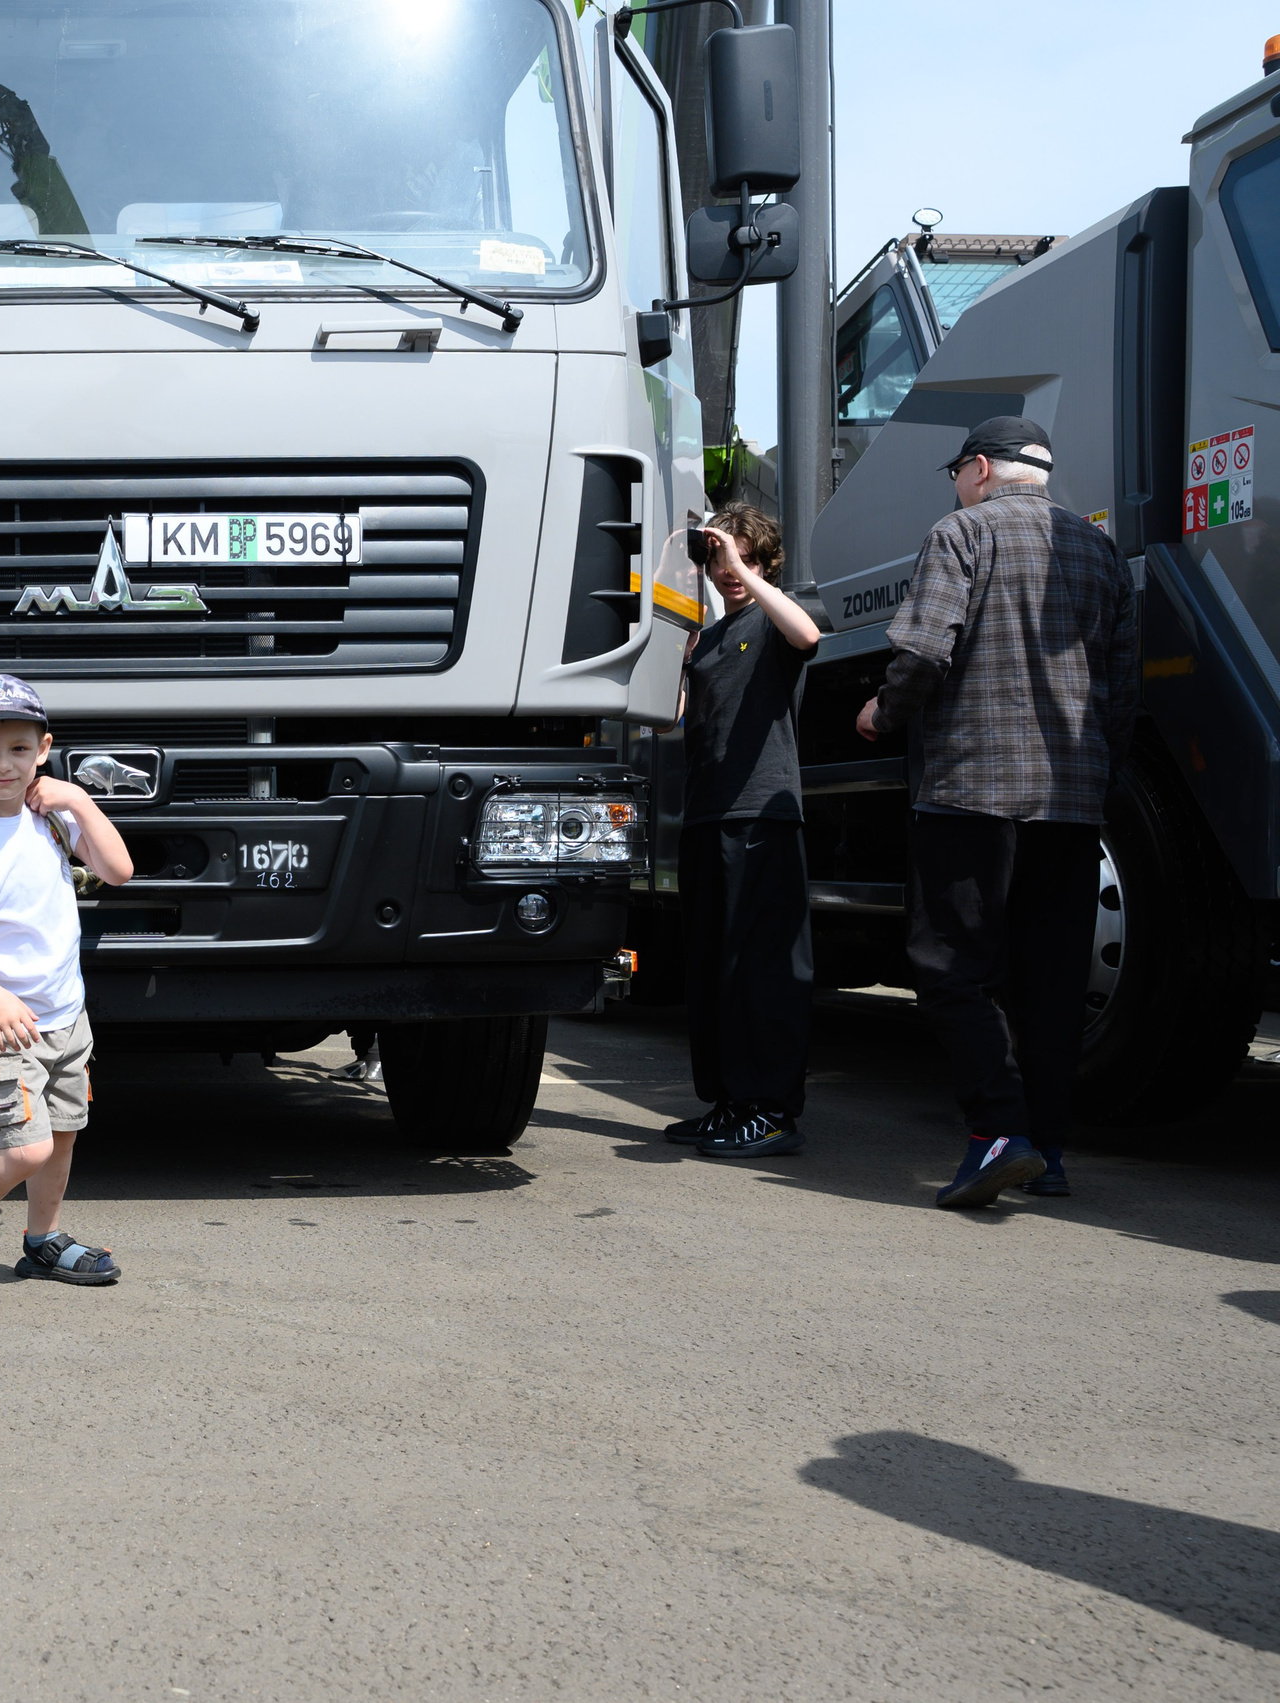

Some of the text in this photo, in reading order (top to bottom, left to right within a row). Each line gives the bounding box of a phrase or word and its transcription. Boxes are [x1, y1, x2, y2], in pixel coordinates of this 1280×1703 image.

[162, 521, 220, 556] KM
[264, 521, 354, 557] 5969
[842, 577, 913, 620] ZOOMLIO
